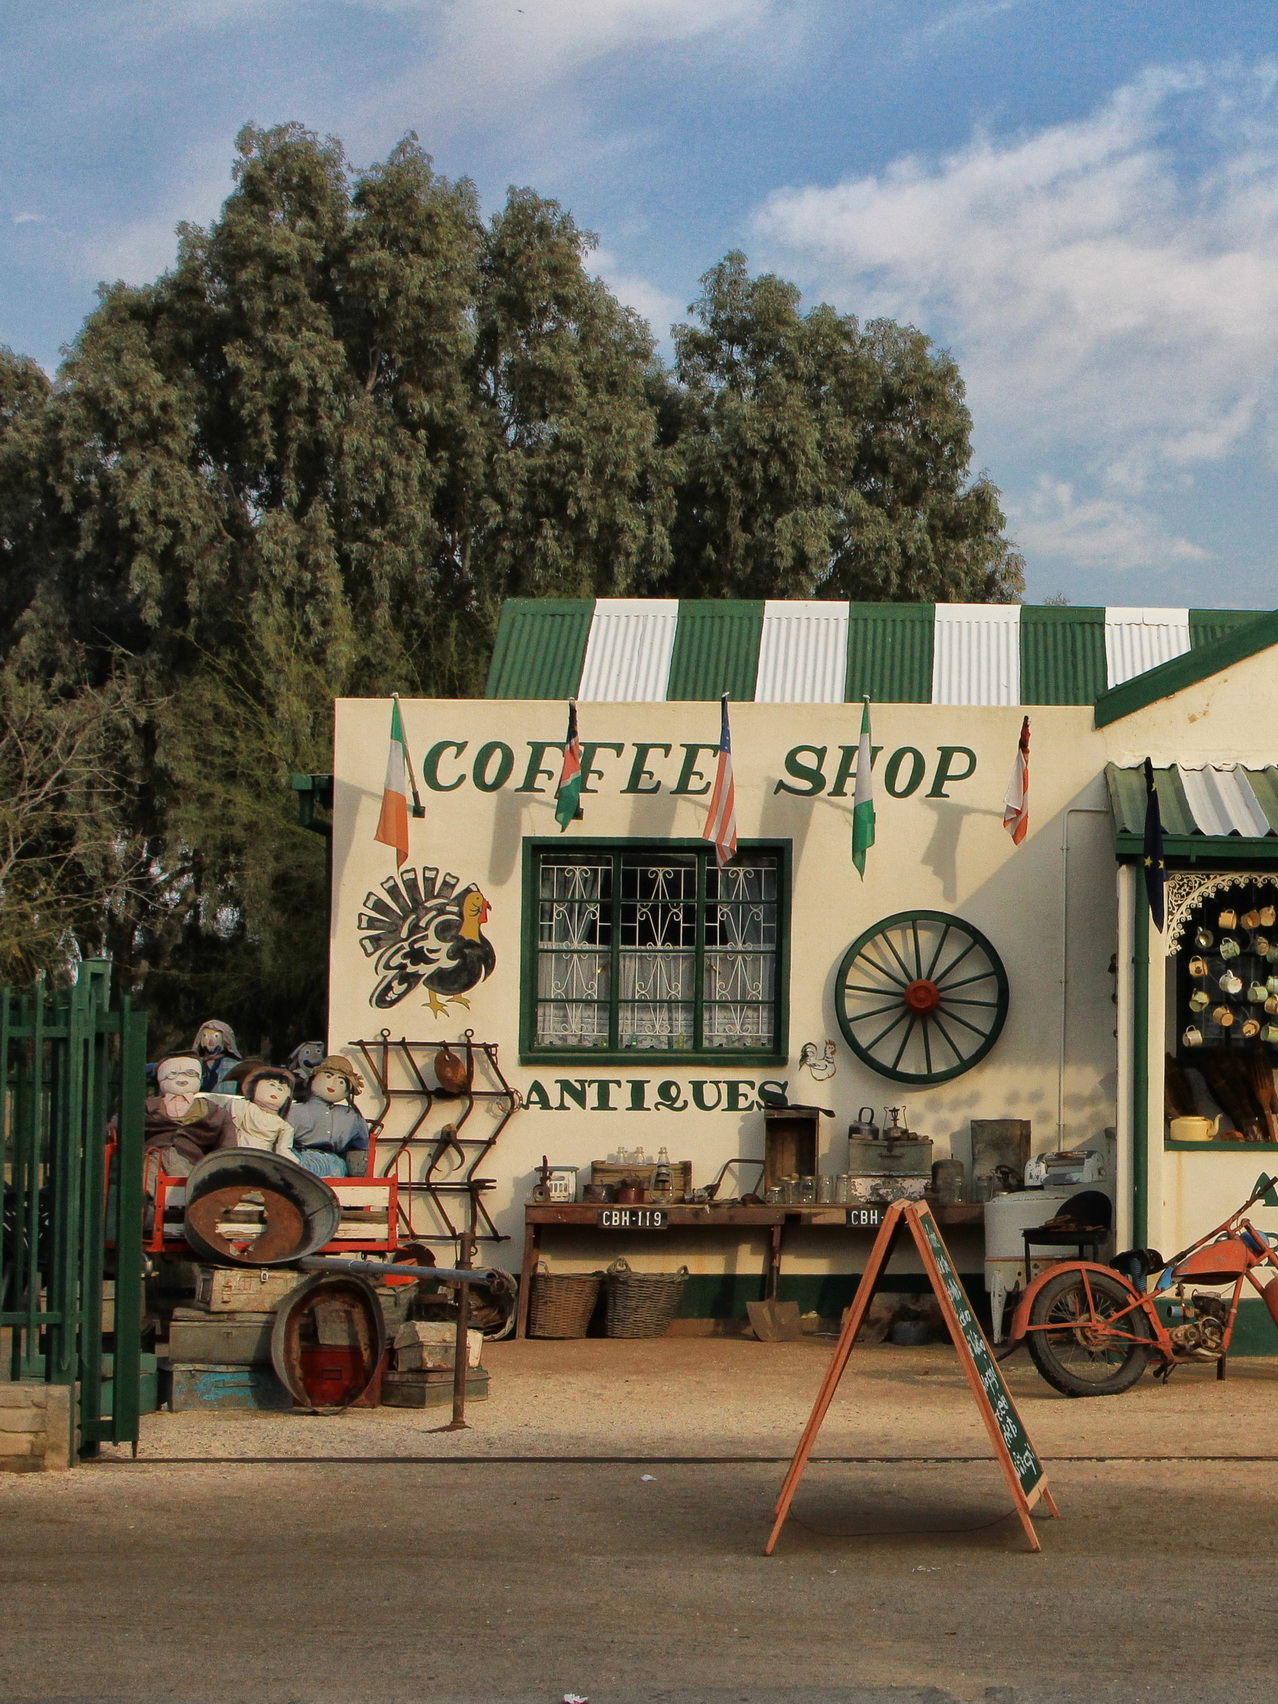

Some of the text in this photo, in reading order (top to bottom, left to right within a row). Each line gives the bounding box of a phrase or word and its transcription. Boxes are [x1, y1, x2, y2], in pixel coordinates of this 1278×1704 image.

[423, 739, 977, 799] COFFEE SHOP
[521, 1079, 788, 1112] ANTIQUES
